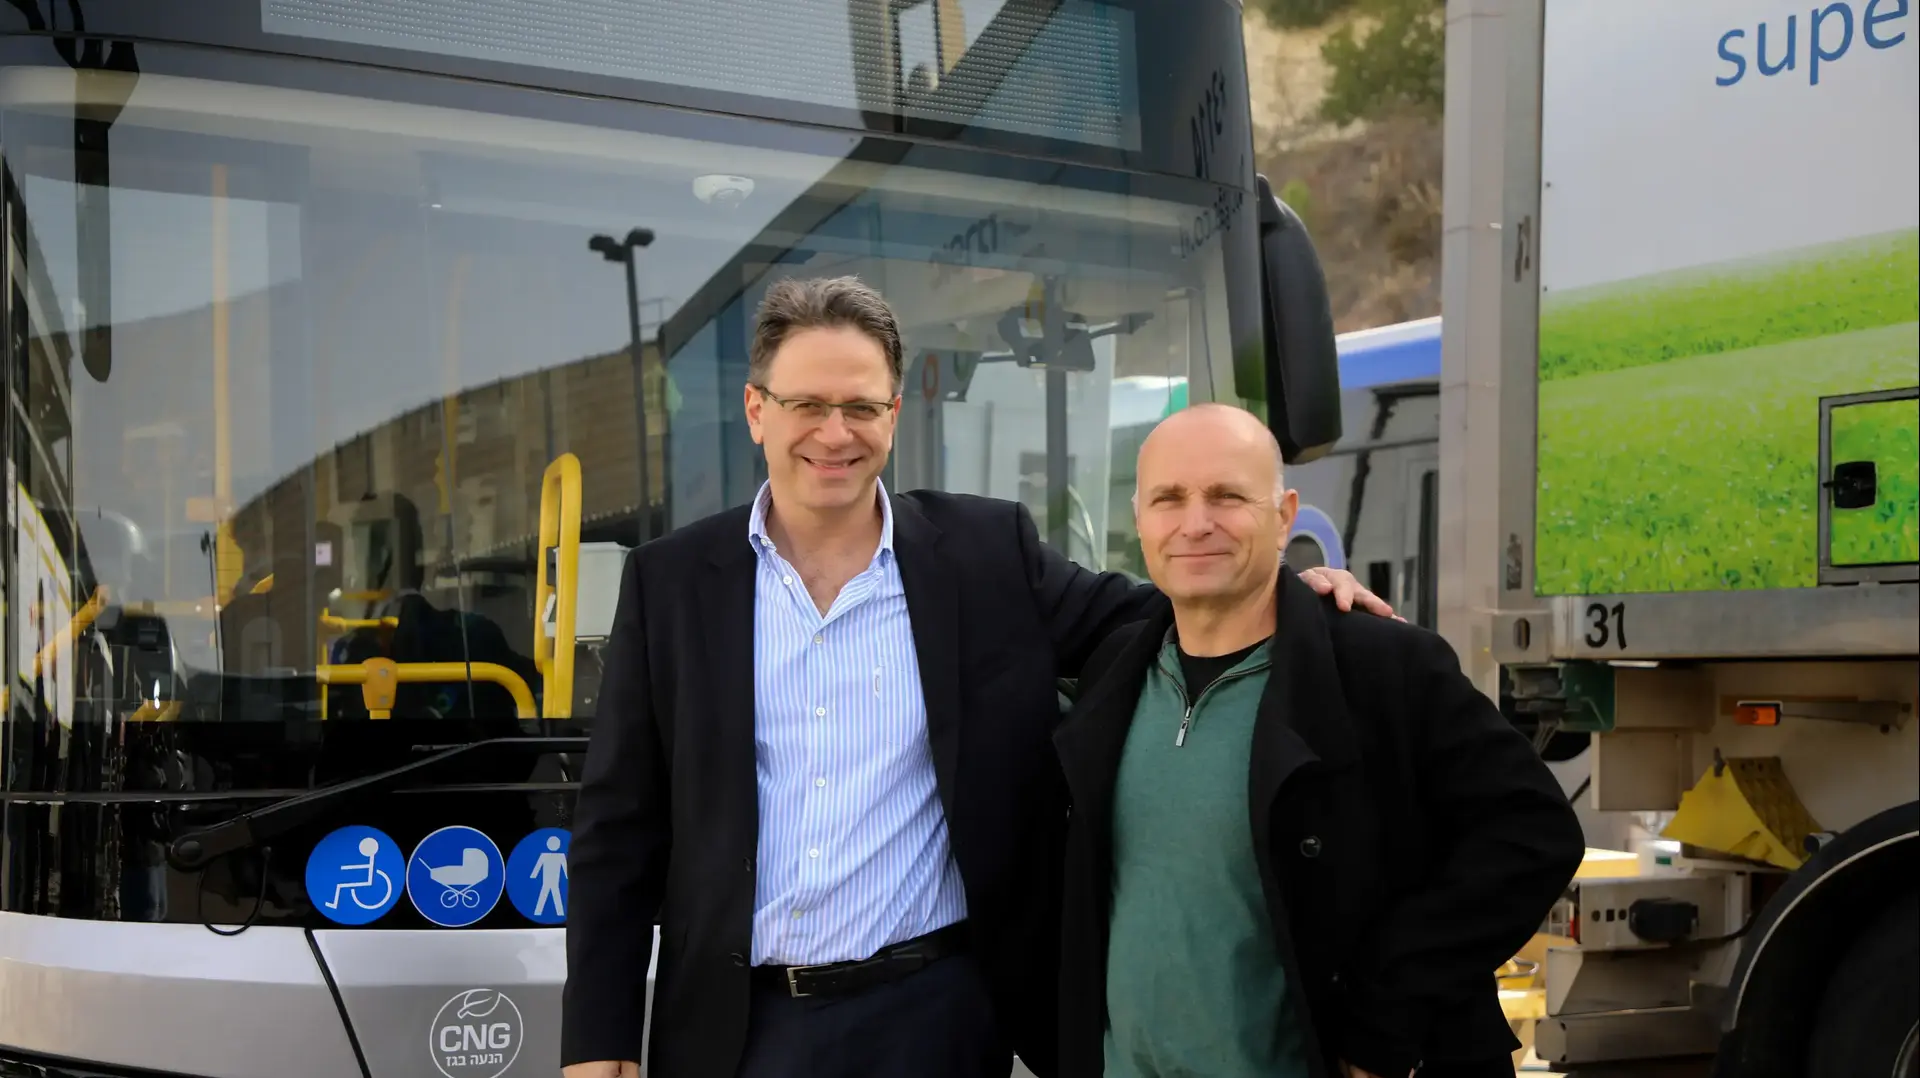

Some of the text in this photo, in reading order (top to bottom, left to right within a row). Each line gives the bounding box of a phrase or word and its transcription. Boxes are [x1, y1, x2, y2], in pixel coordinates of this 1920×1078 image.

[1715, 0, 1909, 87] supe
[1584, 601, 1628, 651] 31
[440, 1022, 511, 1052] CNG
[445, 1053, 503, 1067] הנעה בגז
